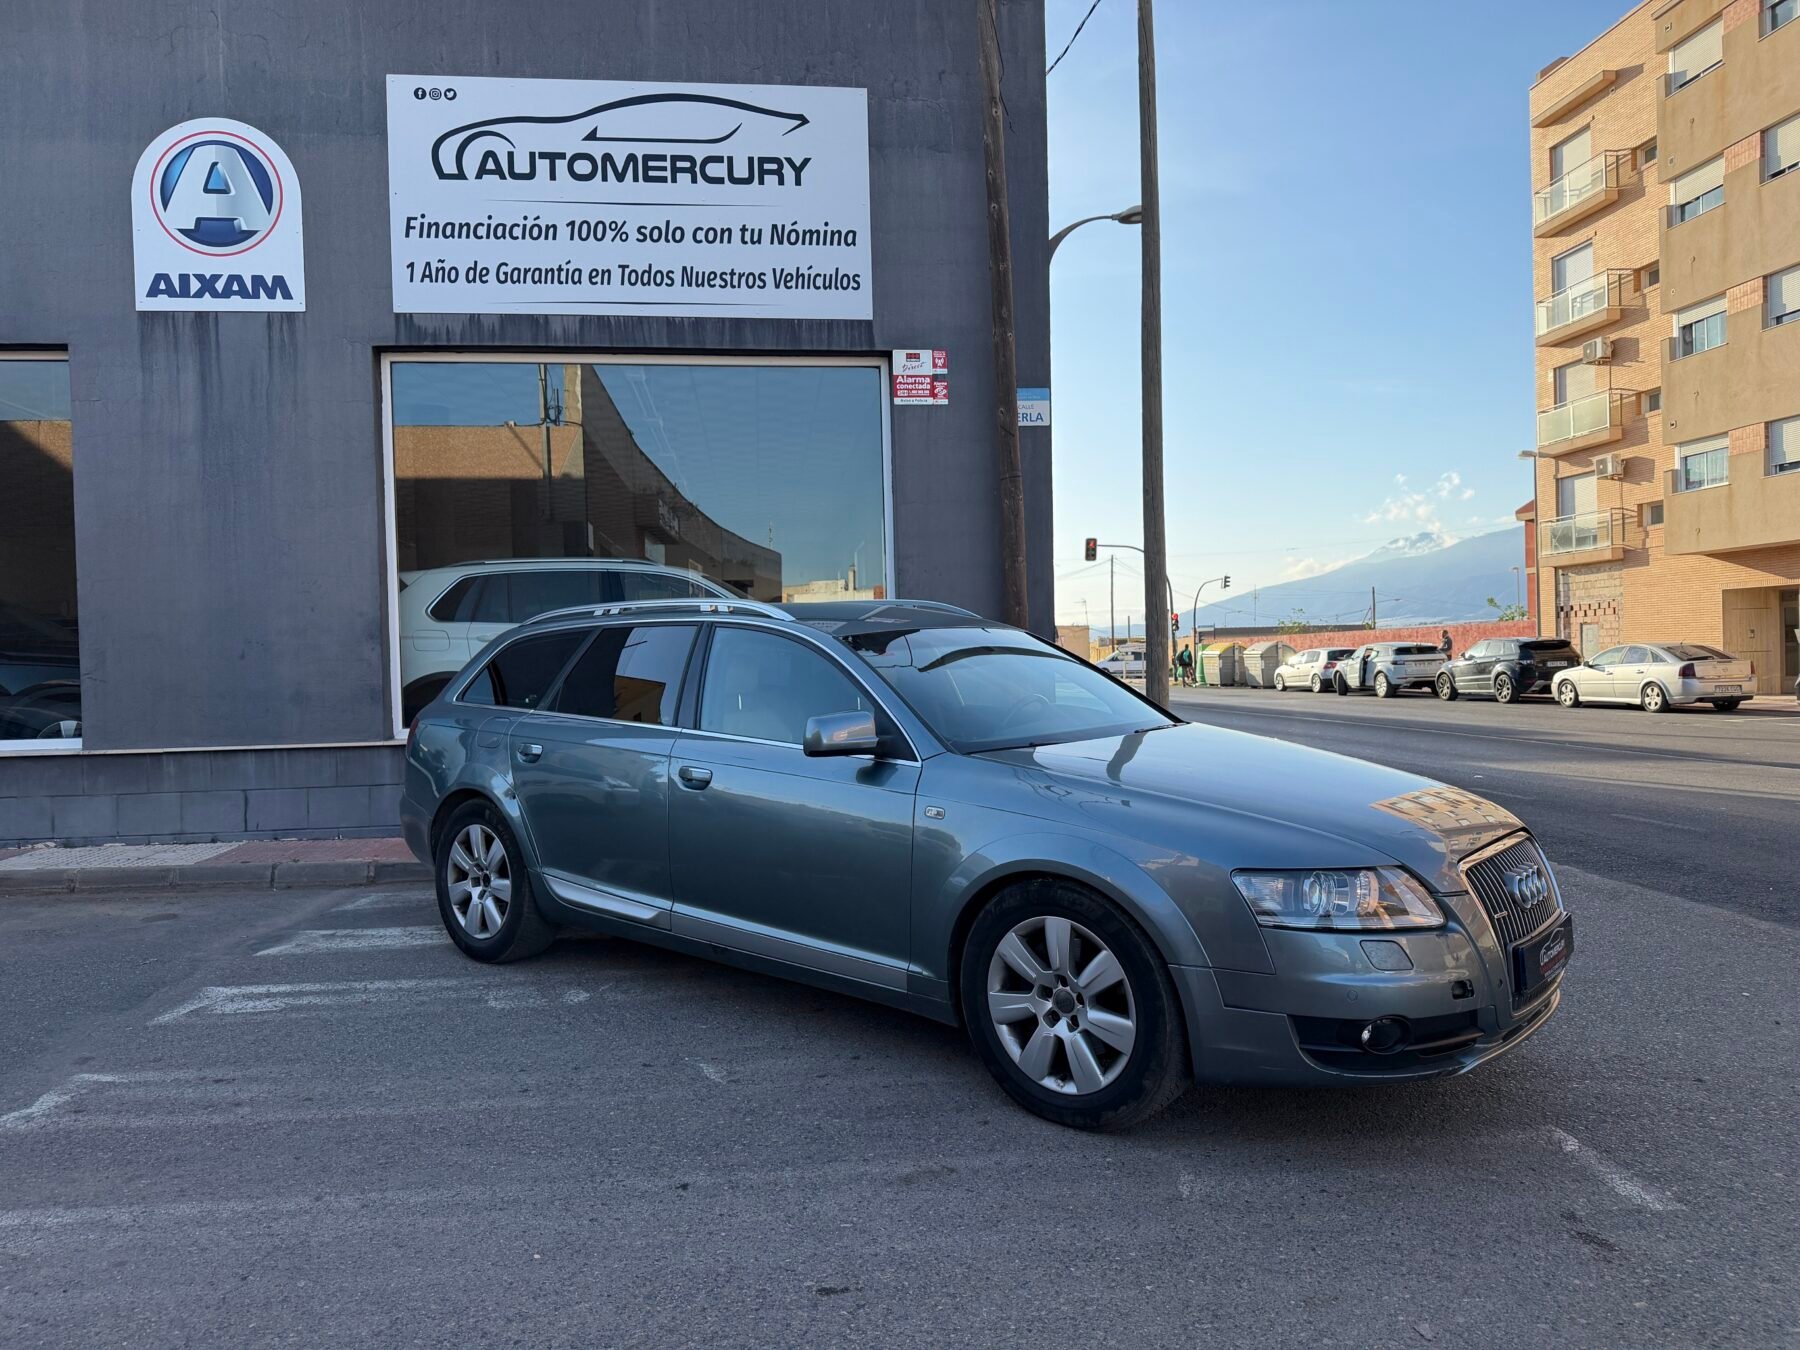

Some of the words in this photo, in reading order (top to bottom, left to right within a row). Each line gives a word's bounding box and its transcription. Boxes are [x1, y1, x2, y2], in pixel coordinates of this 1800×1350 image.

[475, 149, 813, 187] AUTOMERCURY
[404, 213, 558, 241] Financiación
[565, 219, 630, 243] 100%
[636, 219, 686, 244] solo
[692, 226, 733, 245] con
[739, 223, 763, 246] tu
[769, 220, 858, 247] Nómina
[146, 273, 294, 300] AIXAM
[406, 261, 415, 283] 1
[420, 258, 460, 284] Año
[465, 260, 490, 285] de
[496, 259, 583, 286] Garantía
[588, 267, 612, 286] en
[618, 263, 675, 288] Todos
[681, 265, 767, 290] Nuestros
[771, 264, 861, 291] Vehículos
[896, 375, 930, 383] Alarma
